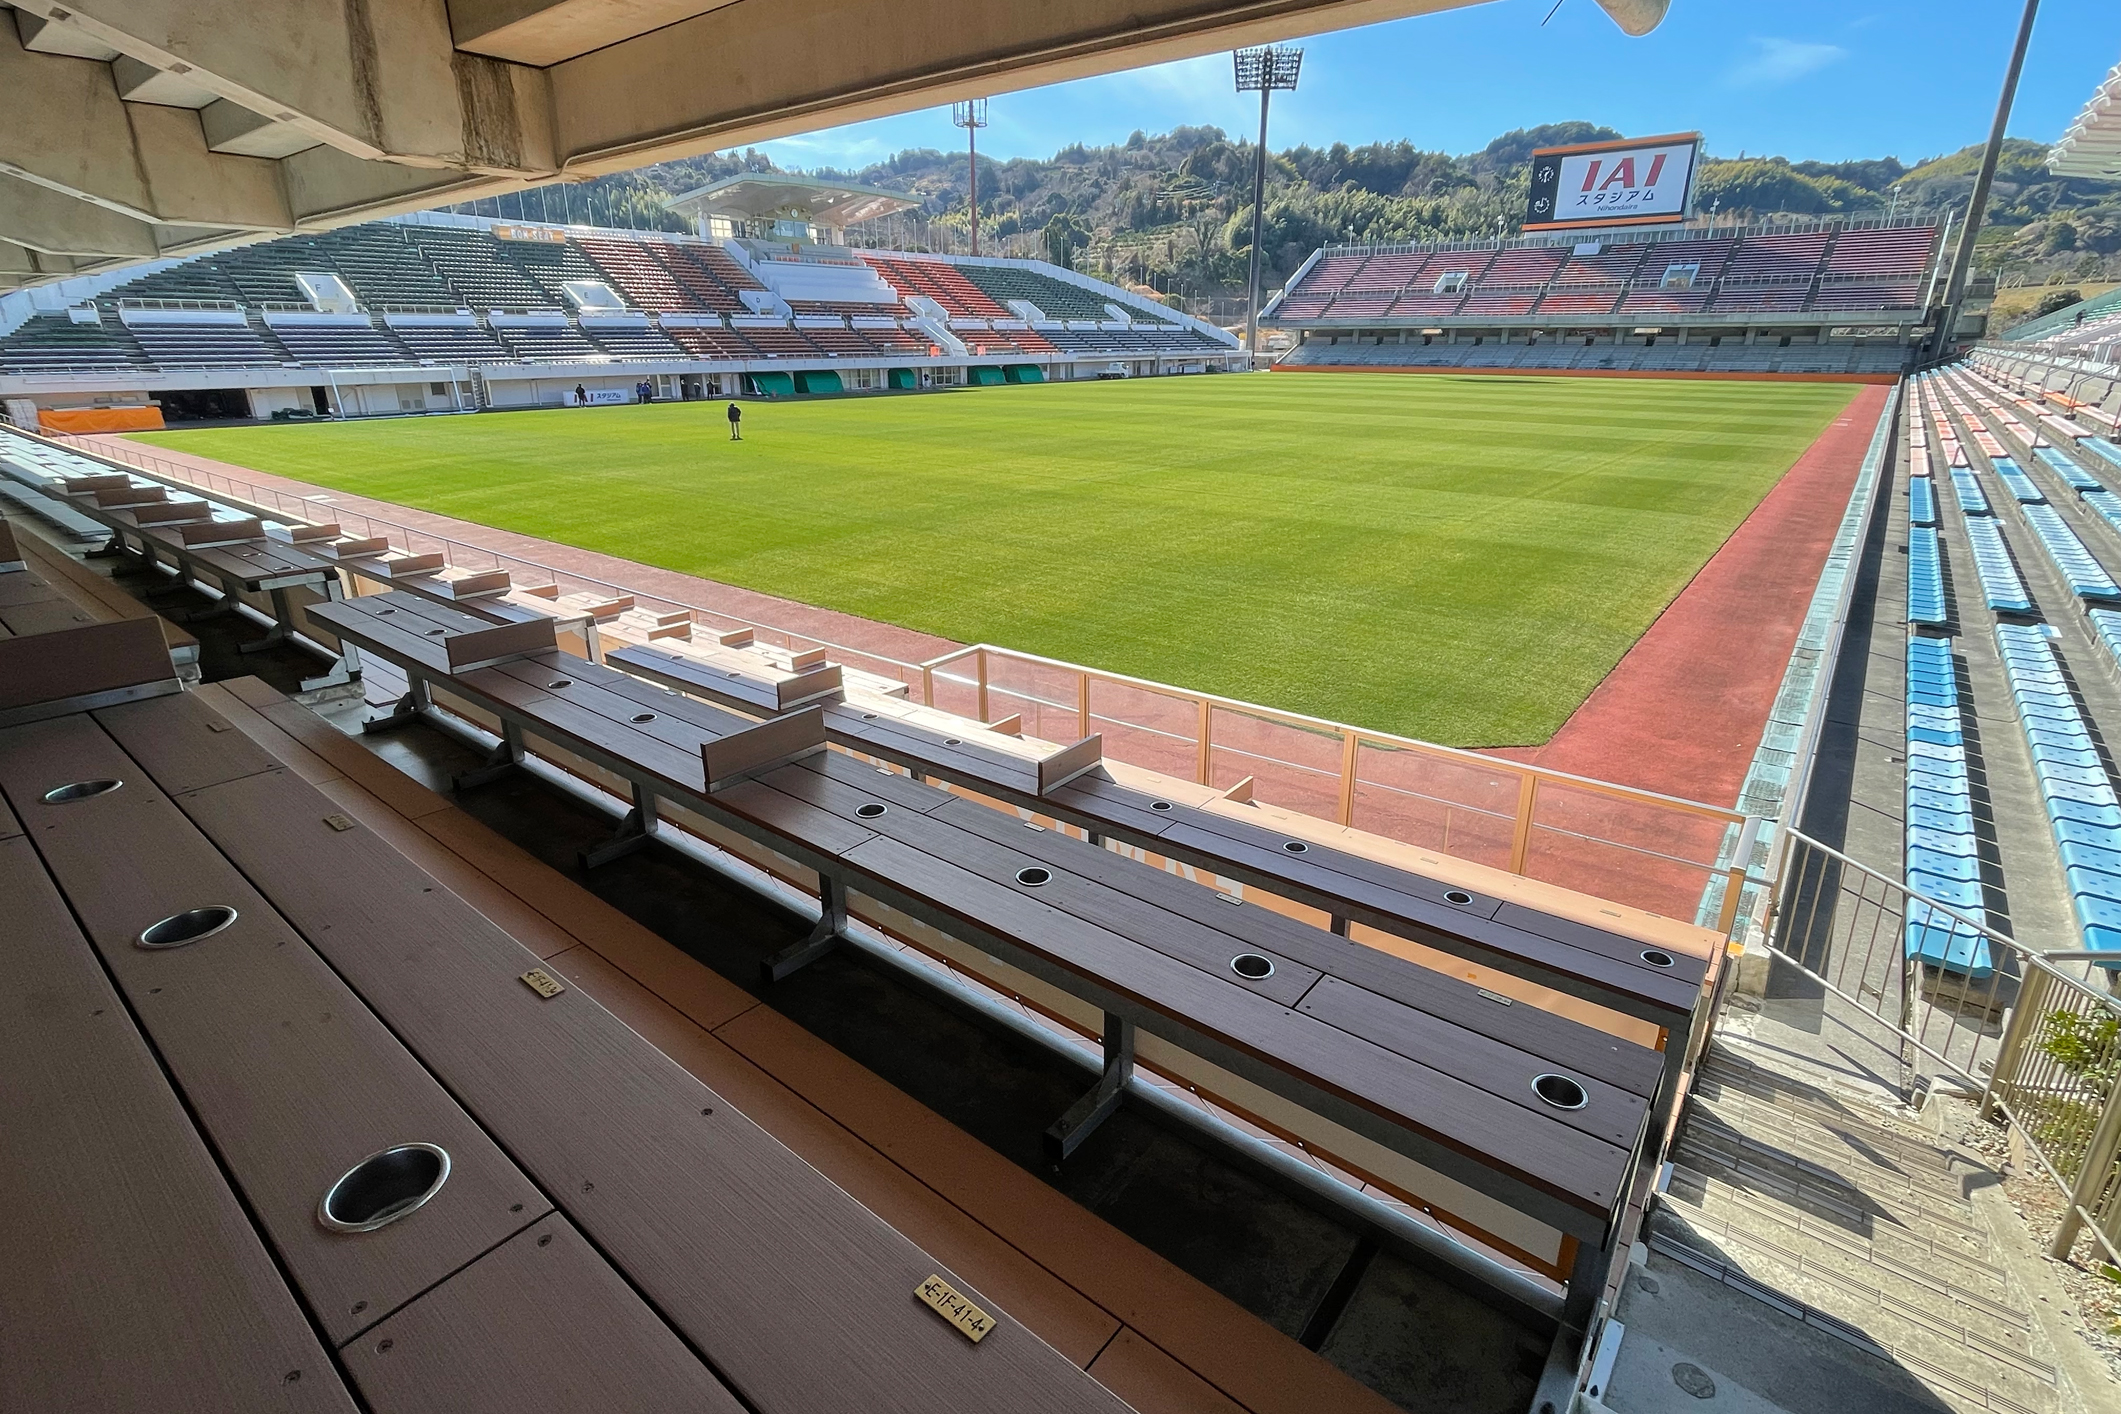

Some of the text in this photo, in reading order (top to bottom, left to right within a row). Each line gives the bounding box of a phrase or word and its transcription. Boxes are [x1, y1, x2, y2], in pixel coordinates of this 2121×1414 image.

[1581, 153, 1667, 192] IAI
[1576, 189, 1654, 206] スタジアム
[1597, 204, 1638, 212] Nihondaira
[315, 283, 321, 291] F
[925, 1282, 984, 1332] E-1F-41-4
